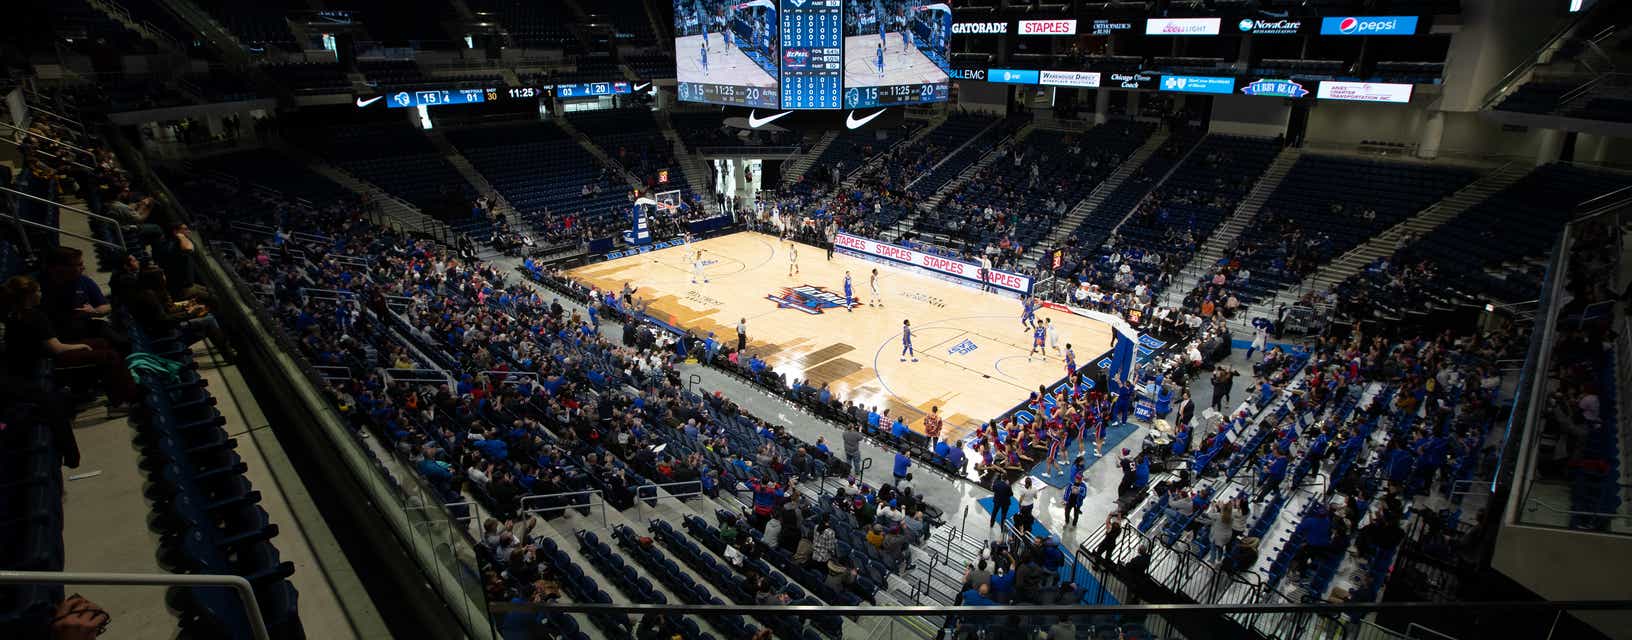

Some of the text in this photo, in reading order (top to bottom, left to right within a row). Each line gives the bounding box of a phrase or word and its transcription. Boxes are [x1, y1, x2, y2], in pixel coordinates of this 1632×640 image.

[952, 22, 1008, 34] GATORADE
[1025, 22, 1070, 32] STAPLES
[1252, 20, 1301, 29] NovaCare
[1358, 19, 1397, 32] pepsi
[965, 70, 984, 80] EMC
[508, 88, 534, 97] 11:25
[595, 84, 605, 93] 20
[694, 84, 704, 95] 15
[715, 86, 734, 96] 11:25
[890, 86, 910, 96] 11:25
[921, 85, 933, 96] 20
[423, 93, 435, 103] 15
[467, 93, 478, 102] 01
[487, 92, 497, 100] 30
[746, 88, 759, 100] 20
[865, 88, 877, 100] 15
[834, 233, 1021, 288] STAPLES STAPLES STAPLES SAPLES
